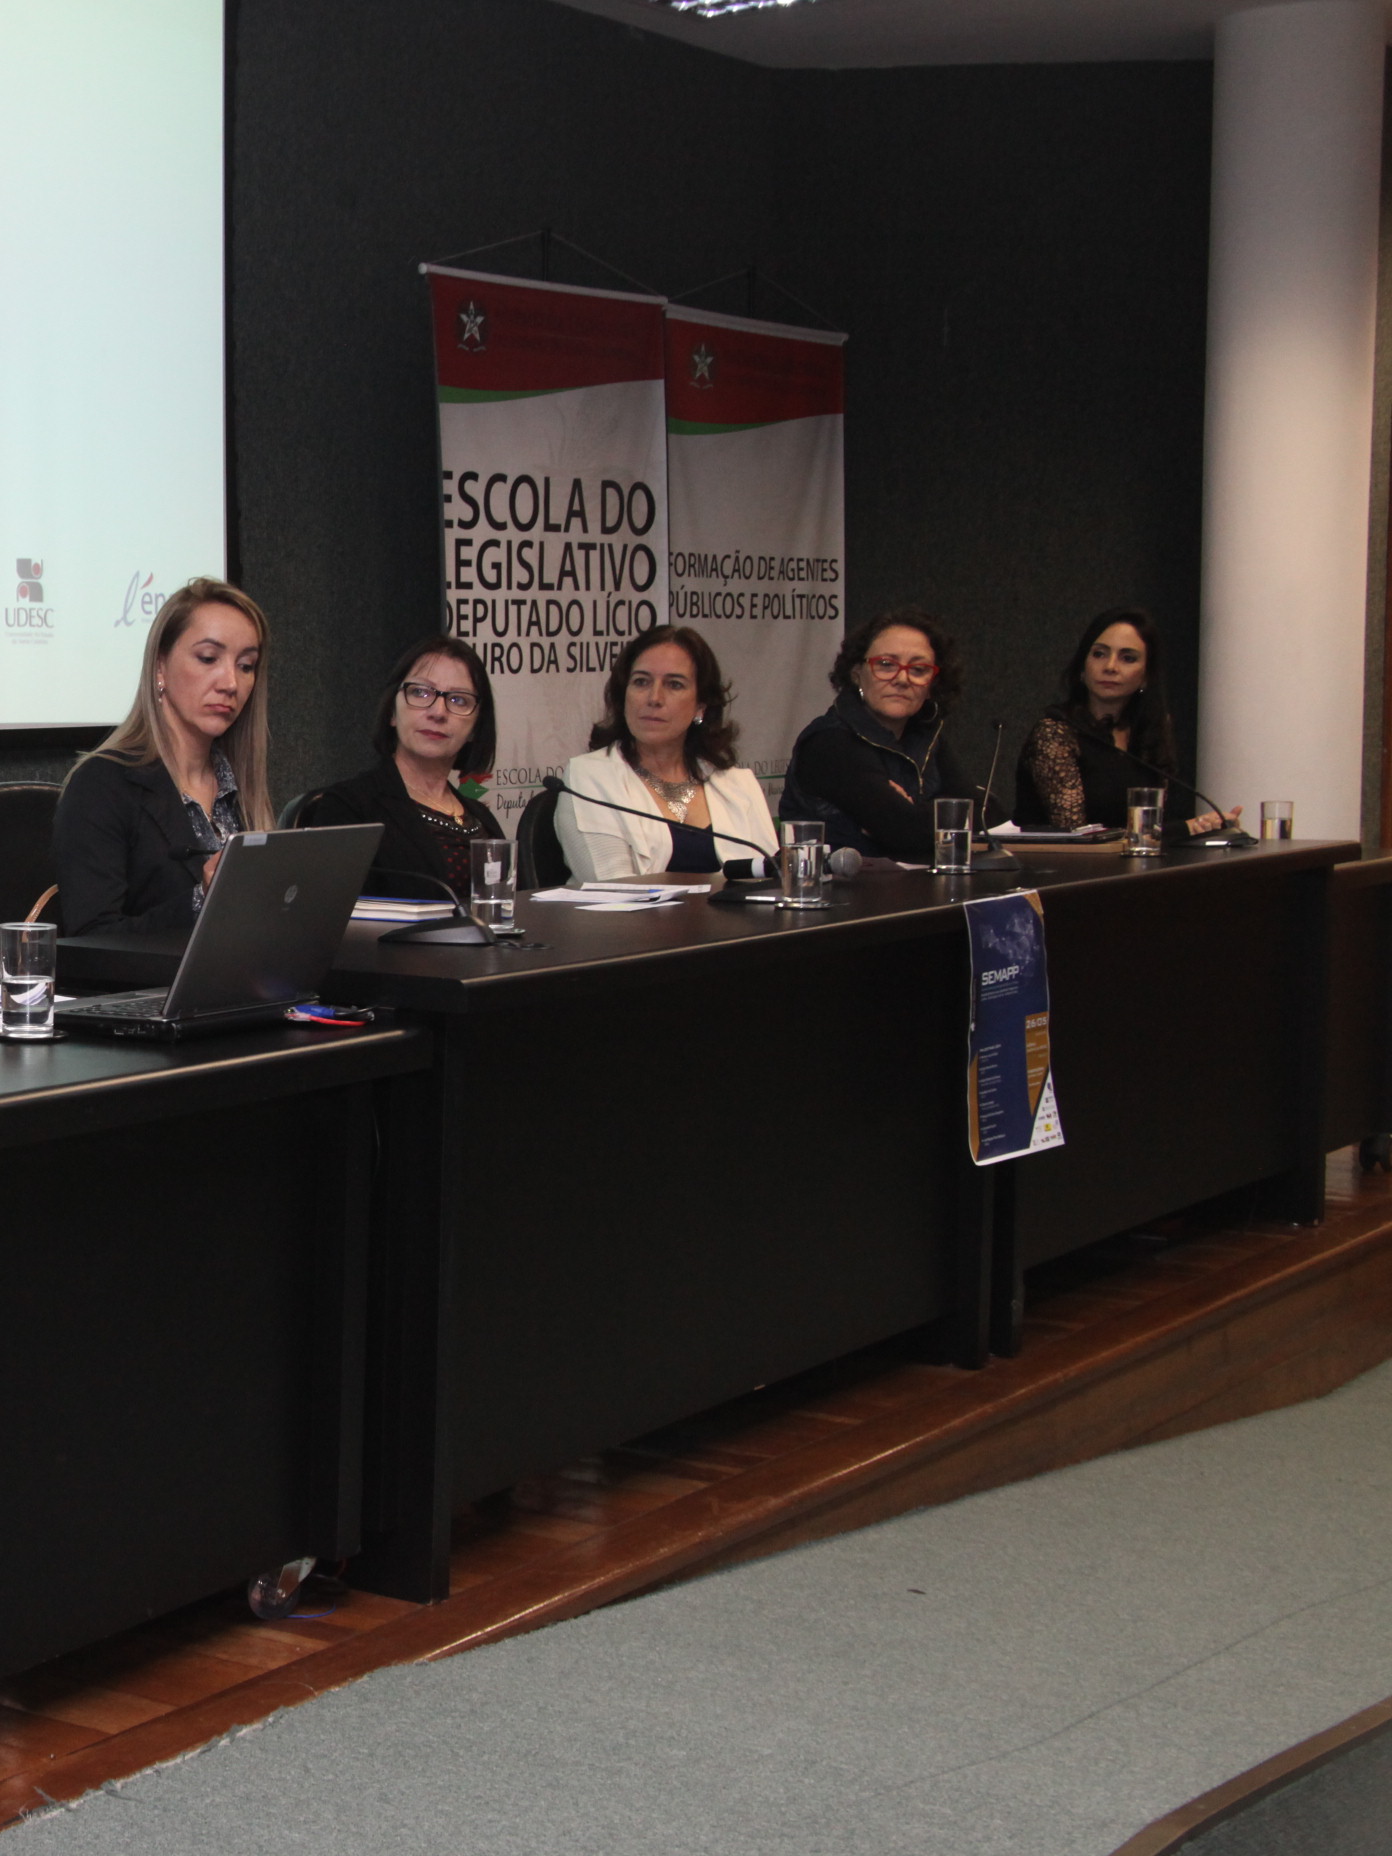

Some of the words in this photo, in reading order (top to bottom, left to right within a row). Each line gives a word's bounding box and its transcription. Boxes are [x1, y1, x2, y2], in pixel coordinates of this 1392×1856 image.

[600, 479, 656, 536] DO
[446, 538, 657, 593] EGISLATIVO
[757, 556, 776, 581] DE
[777, 557, 839, 583] AGENTES
[5, 608, 54, 628] UDESC
[592, 591, 658, 637] LÍCIO
[749, 593, 758, 620] E
[762, 588, 839, 620] POLÍTICOS
[530, 642, 560, 674] DA
[566, 641, 626, 674] SILVE
[496, 767, 542, 786] ESCOLA
[981, 964, 1020, 986] SEMAPP
